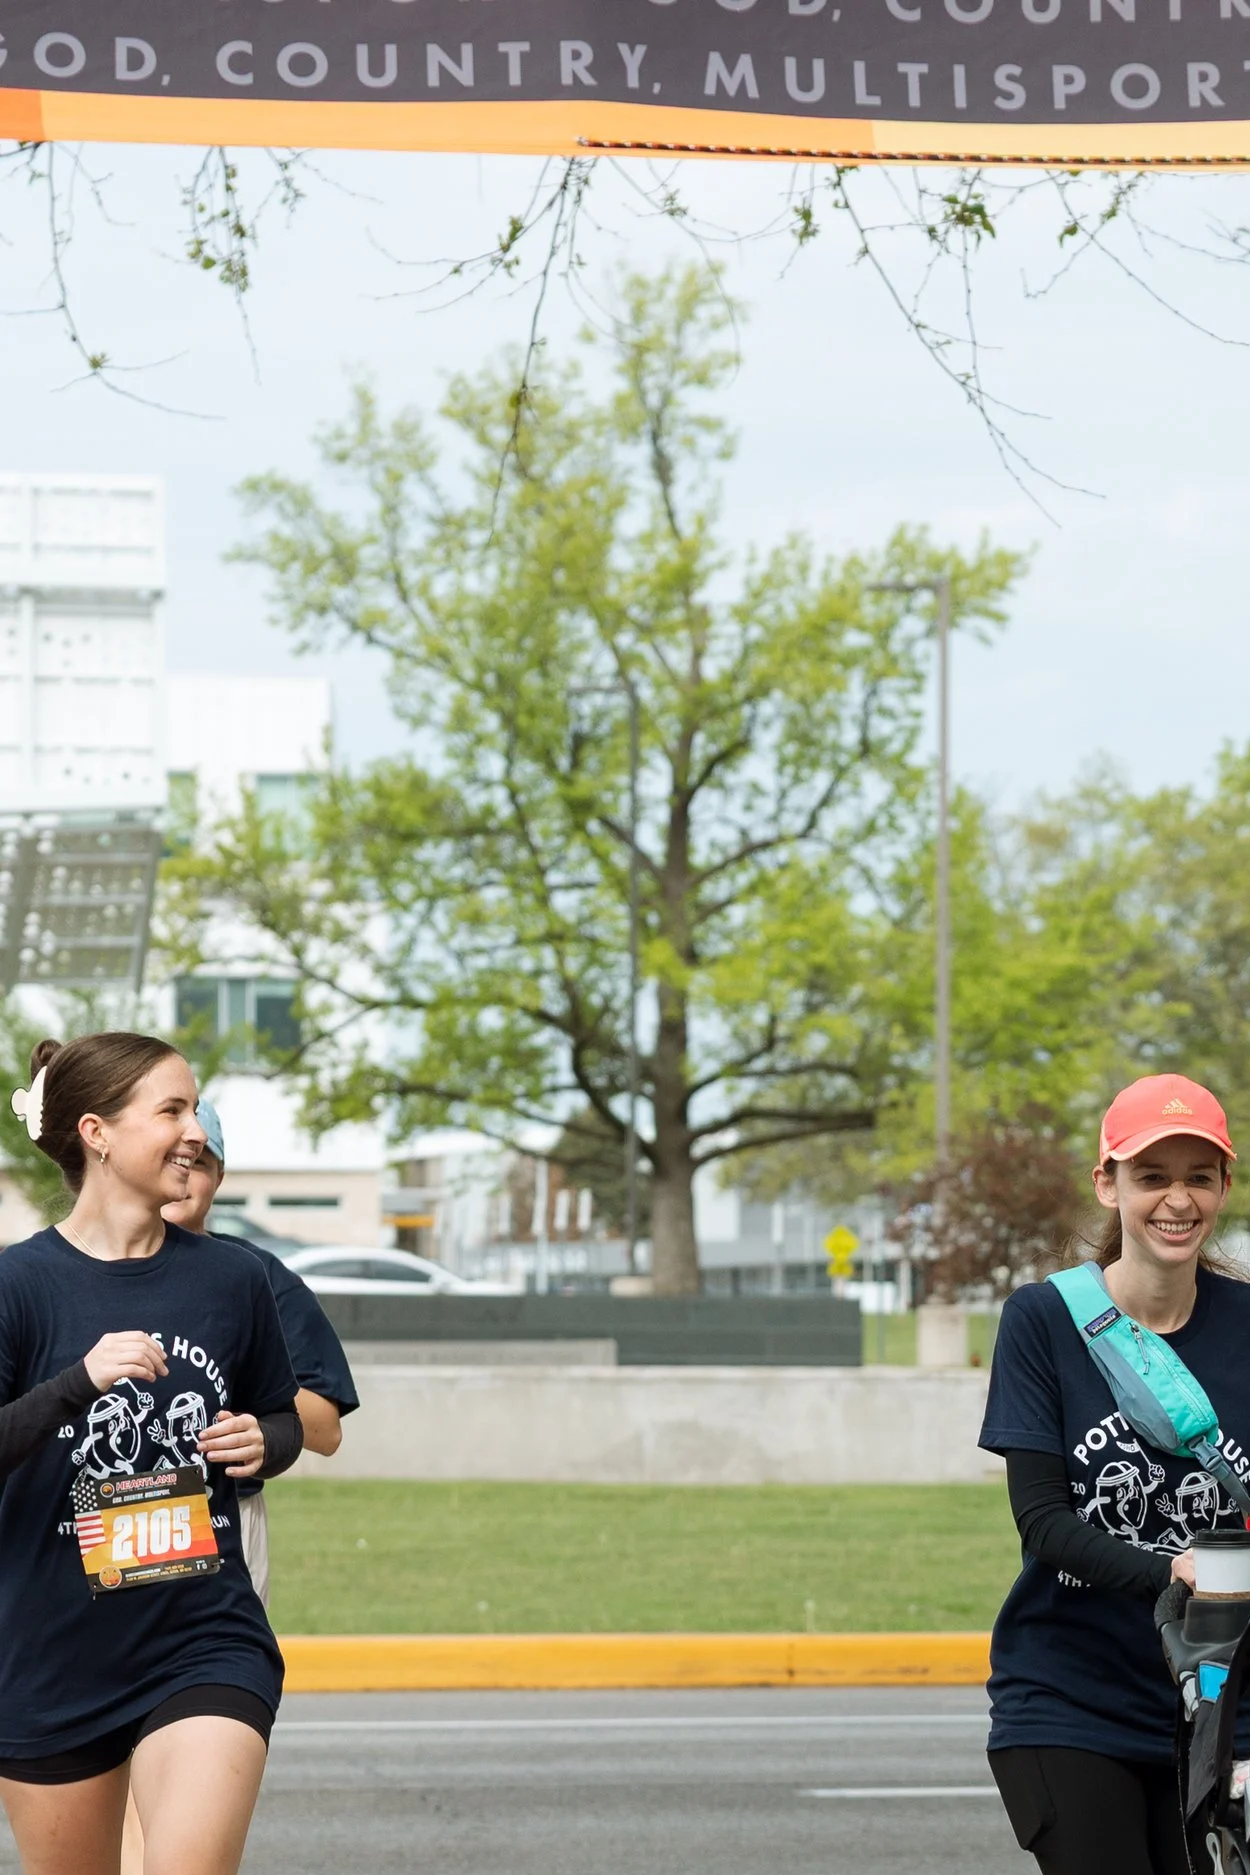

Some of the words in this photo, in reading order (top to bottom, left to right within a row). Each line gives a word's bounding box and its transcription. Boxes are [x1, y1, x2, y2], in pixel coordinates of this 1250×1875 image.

[0, 32, 171, 86] OD,
[216, 39, 661, 95] COUNTRY,
[1162, 1107, 1193, 1116] adidas
[172, 1335, 228, 1406] HOUSE
[57, 1424, 75, 1439] 20
[115, 1472, 178, 1492] HEARTLAND
[1070, 1481, 1086, 1496] 20
[111, 1505, 192, 1562] 2105
[1057, 1569, 1082, 1588] 4TH
